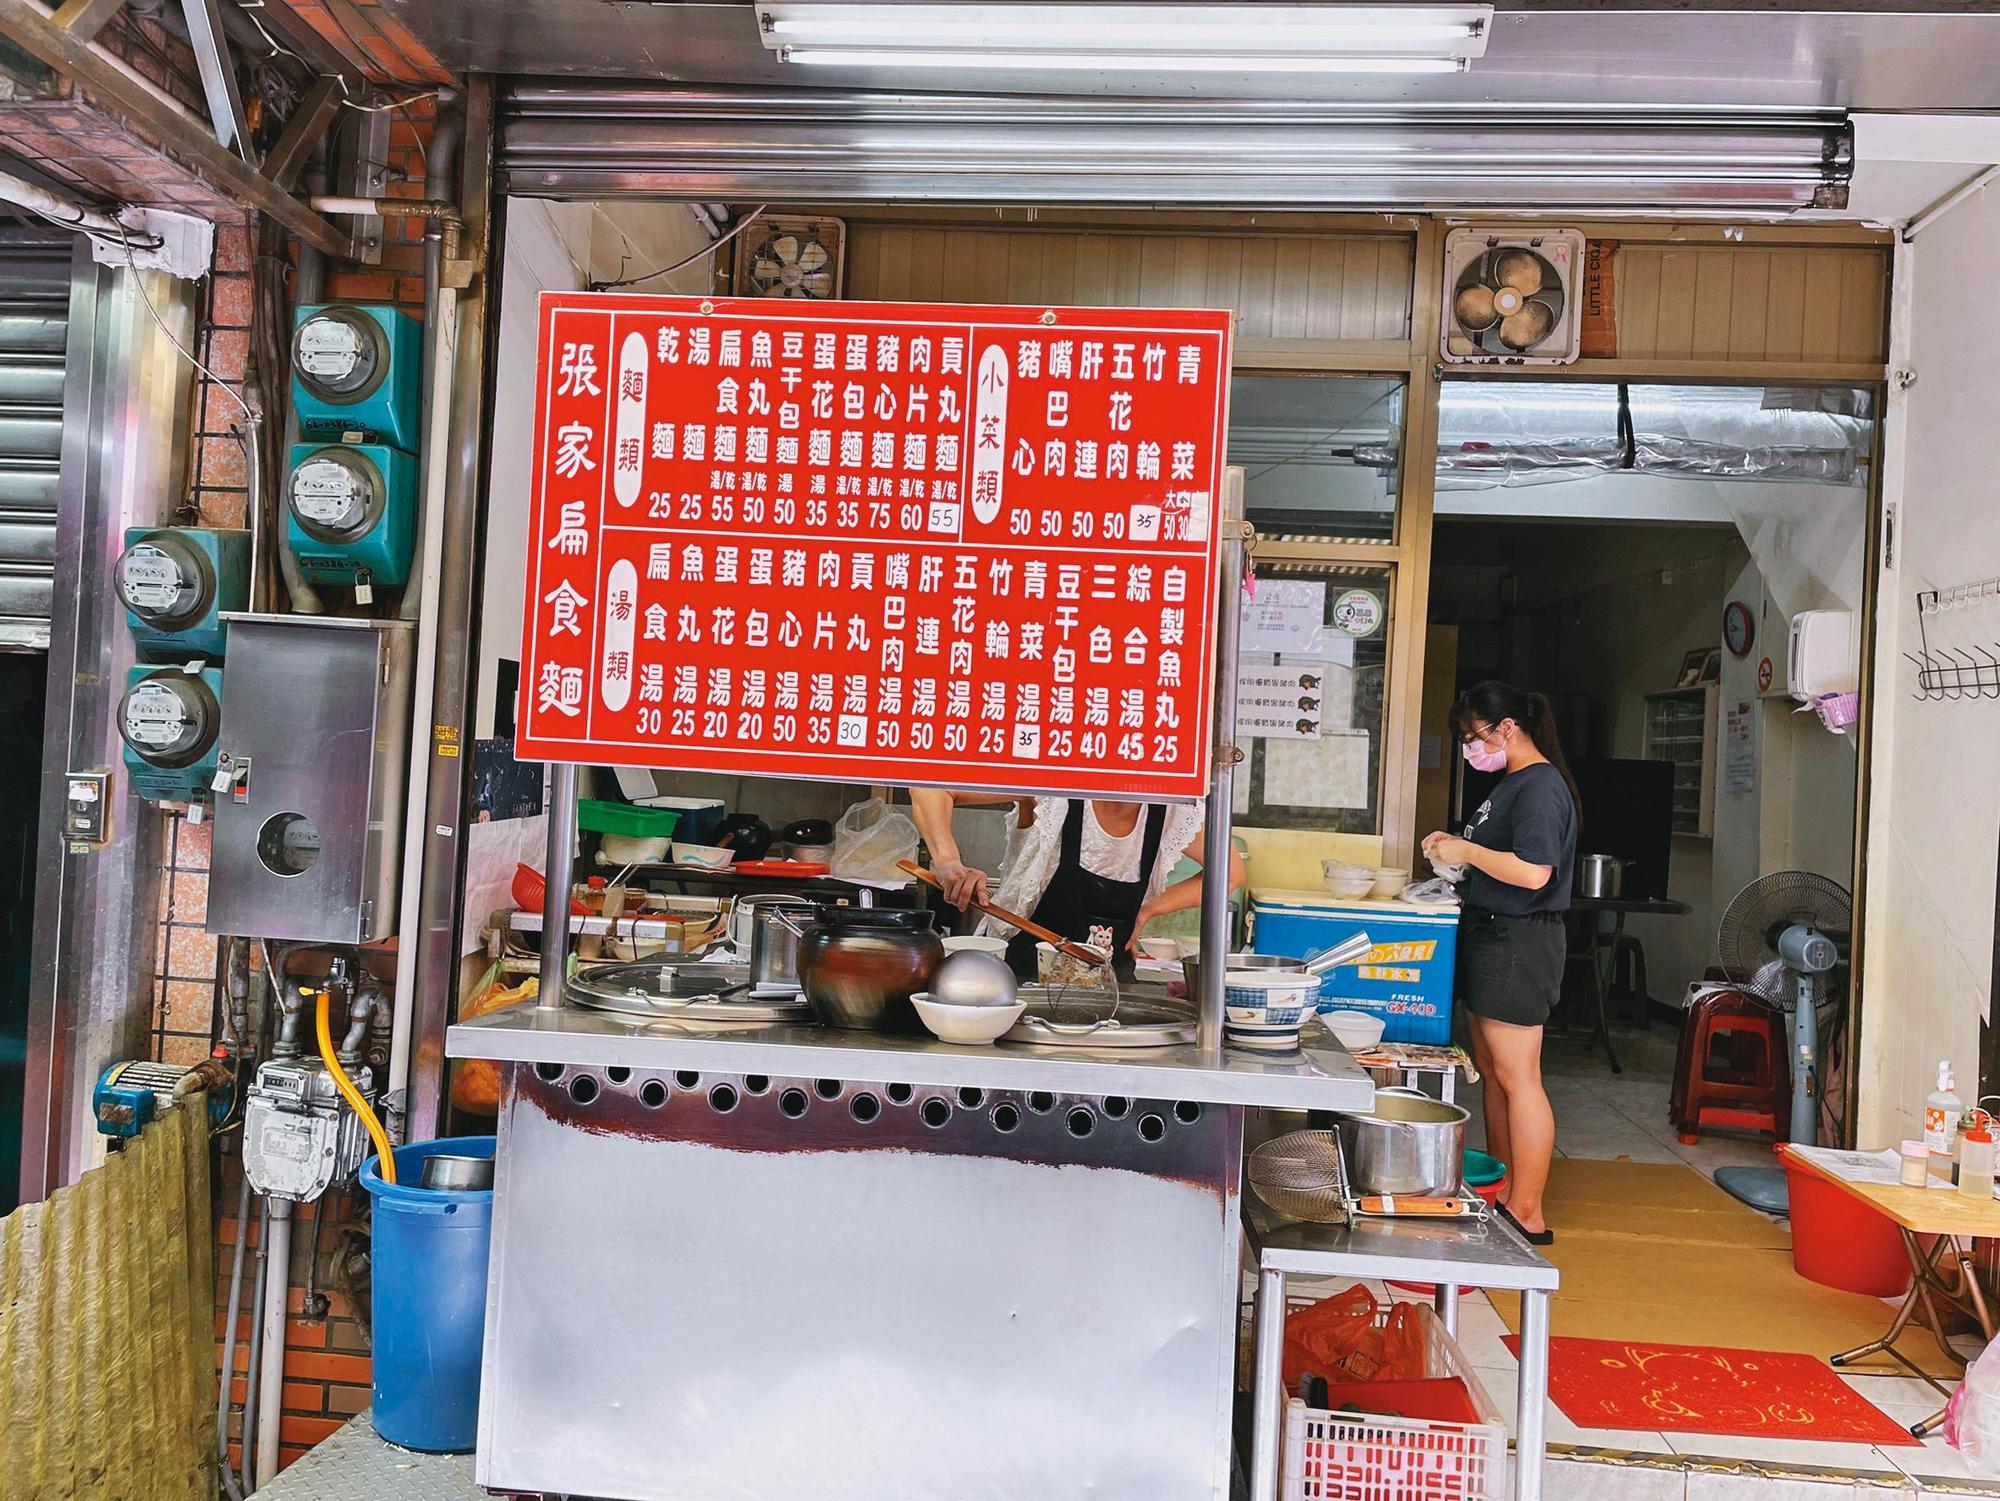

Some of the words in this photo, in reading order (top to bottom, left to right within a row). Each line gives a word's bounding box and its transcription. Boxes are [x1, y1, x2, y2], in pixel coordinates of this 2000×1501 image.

[1590, 274, 1600, 316] LITTLE
[652, 326, 680, 459] 乾麵
[683, 328, 710, 460] 湯麵
[714, 330, 741, 462] 扁食麵
[745, 330, 772, 463] 魚丸麵
[776, 332, 804, 464] 豆干包麵
[808, 333, 836, 465] 蛋花麵
[840, 335, 867, 467] 蛋包麵
[871, 335, 899, 468] 豬心麵
[903, 336, 931, 470] 肉片麵
[935, 337, 963, 471] 貢丸麵
[619, 368, 643, 472] 麵類
[1012, 340, 1041, 475] 豬心
[1044, 340, 1073, 476] 嘴巴肉
[1074, 342, 1103, 478] 肝連
[1106, 344, 1135, 479] 五花肉
[1136, 343, 1166, 480] 竹輪
[1171, 345, 1201, 480] 青菜
[976, 362, 1004, 503] 小菜類
[711, 471, 735, 490] 湯/乾
[742, 472, 767, 491] 湯/乾
[778, 474, 792, 492] 湯
[811, 475, 825, 494] 湯
[836, 476, 861, 495] 湯/乾
[868, 477, 892, 496] 湯/乾
[900, 478, 924, 498] 湯/乾
[932, 480, 957, 500] 湯/乾
[649, 492, 670, 518] 25
[680, 494, 701, 519] 25
[712, 496, 733, 521] 55
[743, 497, 764, 523] 50
[774, 499, 795, 524] 50
[806, 500, 827, 526] 35
[837, 501, 858, 527] 35
[870, 503, 890, 528] 75
[901, 504, 922, 530] 60
[931, 508, 954, 526] 55
[539, 343, 601, 716] 張家扁食麵
[1010, 509, 1031, 535] 50
[1041, 510, 1062, 536] 50
[1072, 512, 1093, 537] 50
[1103, 513, 1124, 539] 50
[1136, 514, 1155, 528] 35
[1164, 515, 1175, 540] 50
[1176, 515, 1188, 540] 30
[606, 591, 632, 680] 湯類
[639, 543, 671, 702] 扁食湯
[673, 544, 703, 704] 魚丸湯
[707, 546, 738, 706] 蛋花湯
[741, 549, 772, 708] 蛋包湯
[775, 549, 806, 709] 豬心湯
[810, 550, 840, 712] 肉片湯
[843, 553, 874, 713] 貢丸湯
[878, 553, 910, 714] 嘴巴肉湯
[912, 556, 943, 716] 肝連湯
[946, 556, 977, 718] 五花肉湯
[981, 559, 1013, 720] 竹輪湯
[1016, 560, 1047, 722] 青菜湯
[1049, 565, 1081, 724] 豆干包湯
[1084, 565, 1116, 726] 三色湯
[1119, 564, 1151, 728] 綜合湯
[1155, 565, 1186, 728] 自製魚丸
[636, 707, 661, 734] 30
[671, 709, 695, 736] 25
[703, 711, 727, 738] 20
[737, 712, 762, 739] 20
[773, 715, 796, 741] 50
[808, 717, 830, 743] 35
[841, 722, 861, 739] 30
[877, 721, 899, 747] 50
[910, 723, 933, 749] 50
[944, 724, 966, 751] 50
[979, 726, 1004, 753] 25
[1019, 732, 1038, 746] 35
[1048, 730, 1072, 757] 25
[1080, 732, 1106, 758] 40
[1118, 732, 1144, 760] 45
[1153, 735, 1177, 762] 25
[1391, 994, 1424, 1002] FRESH
